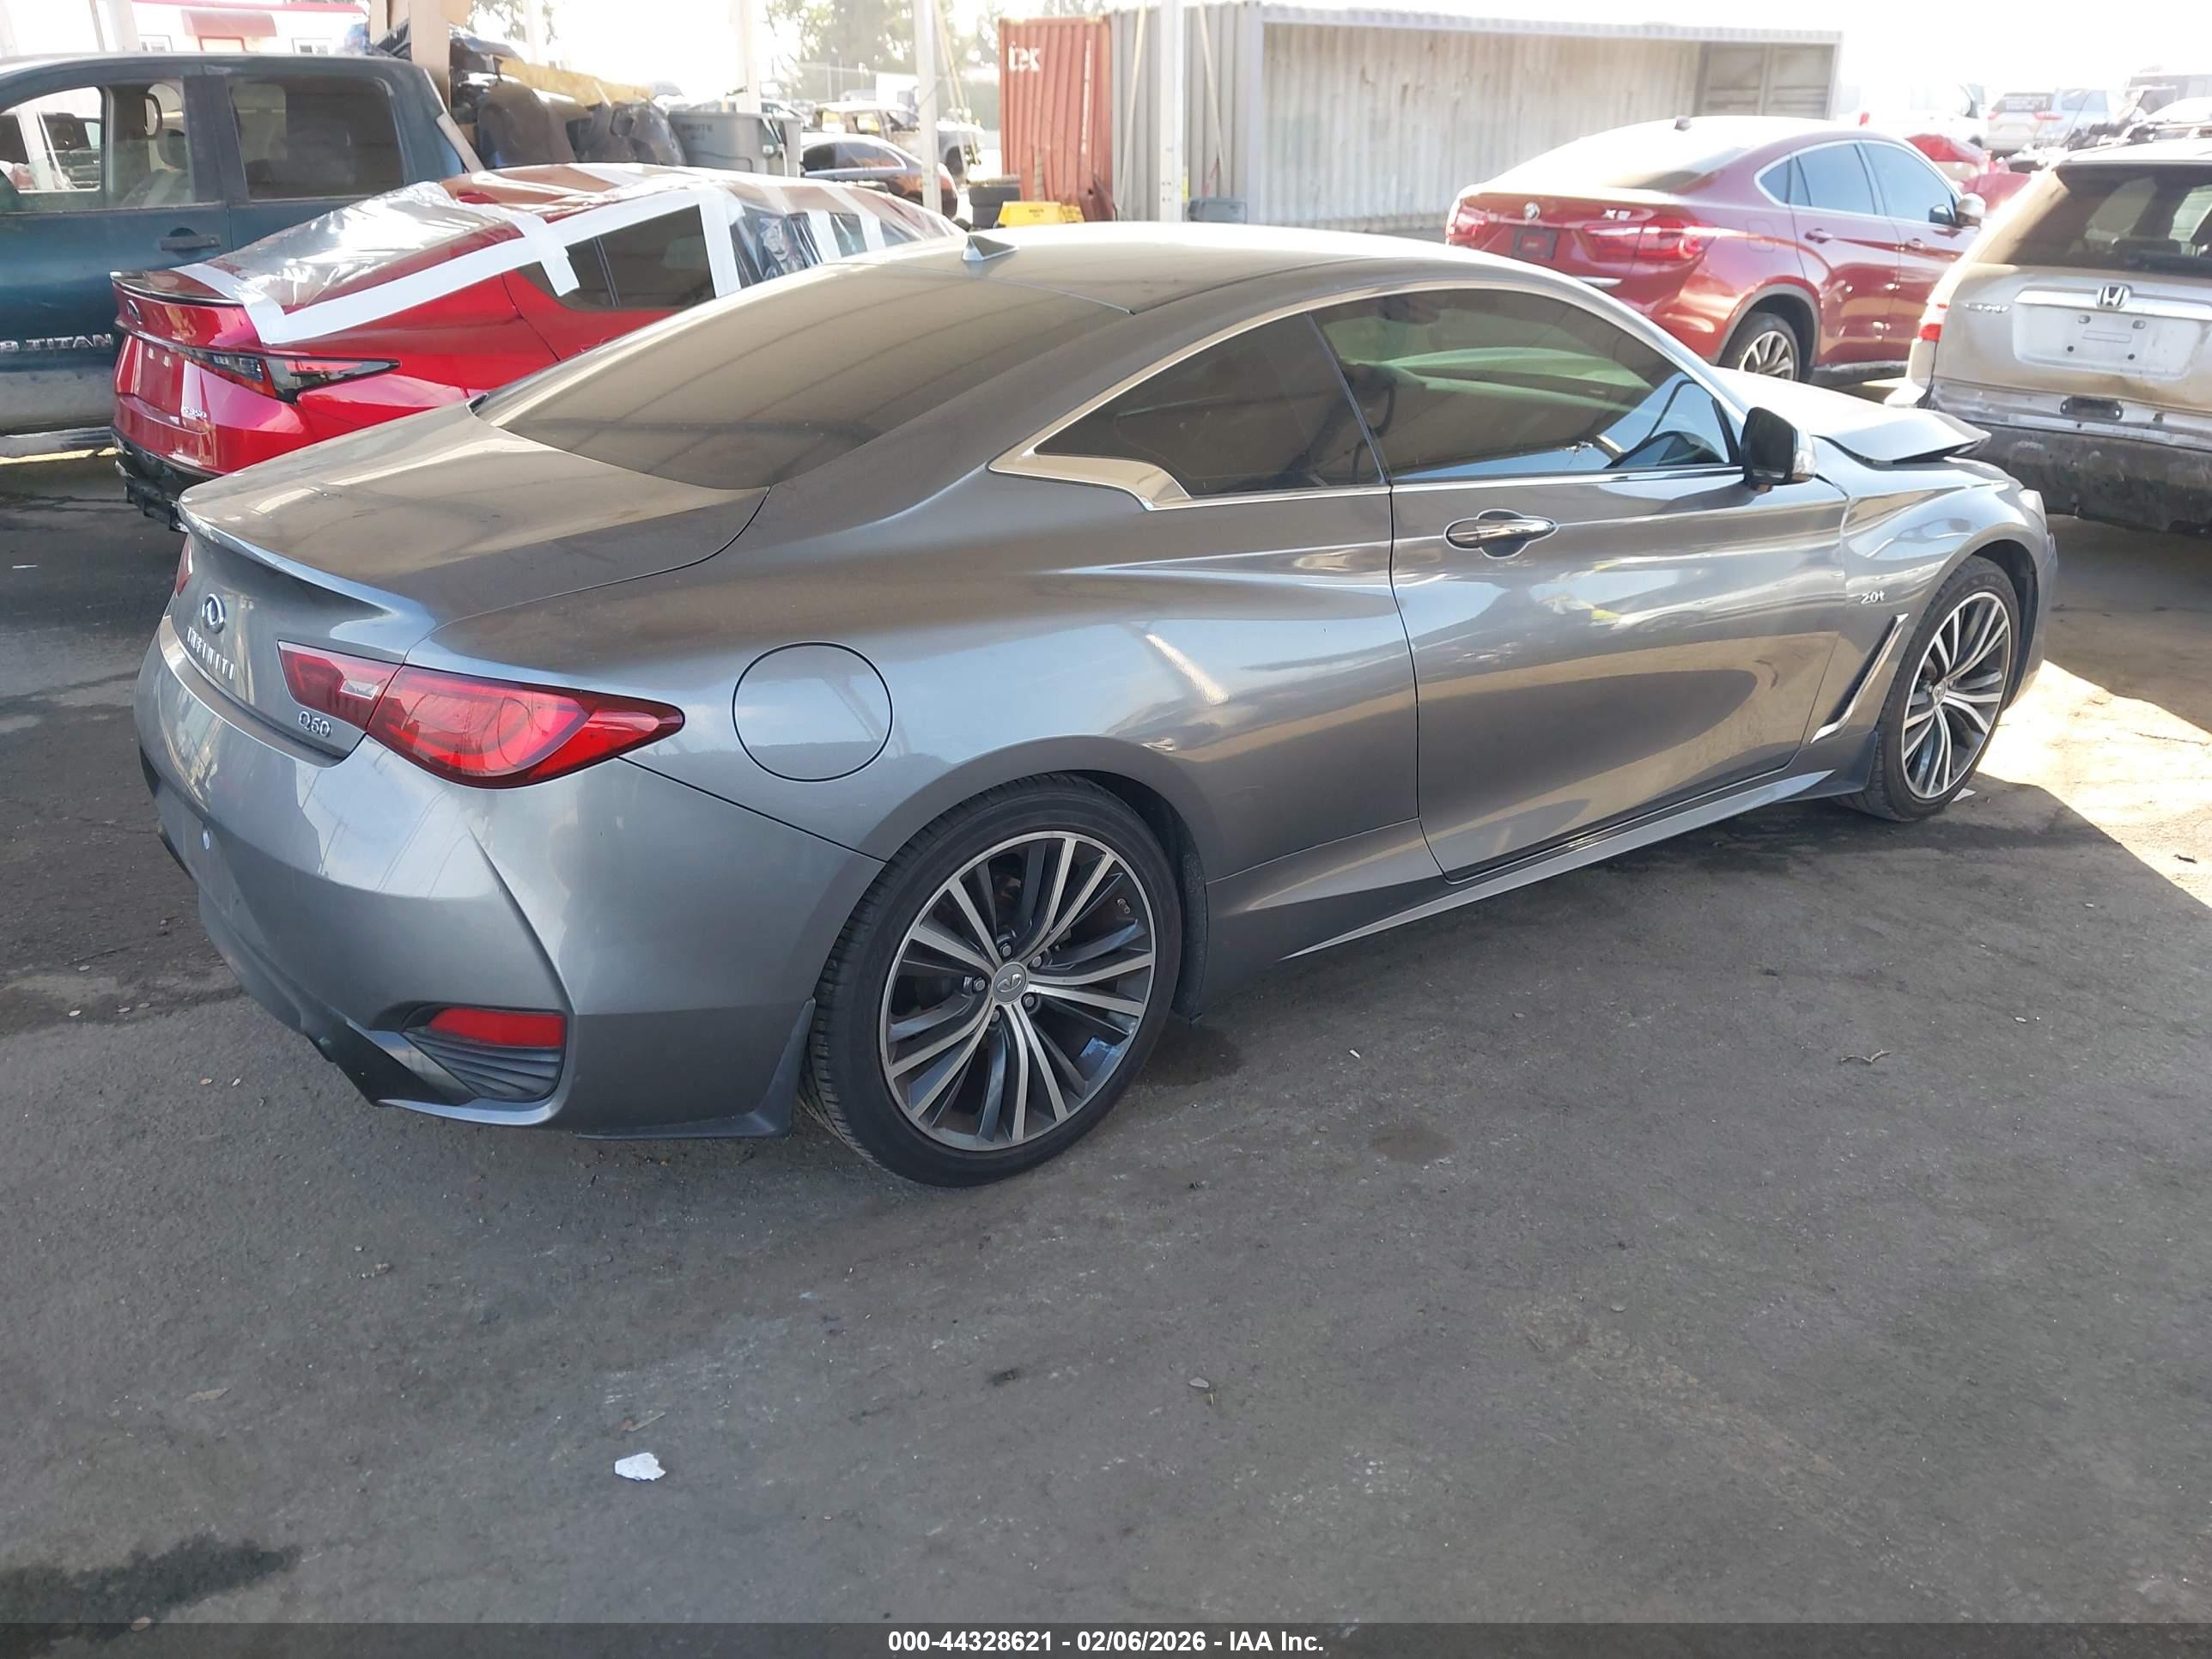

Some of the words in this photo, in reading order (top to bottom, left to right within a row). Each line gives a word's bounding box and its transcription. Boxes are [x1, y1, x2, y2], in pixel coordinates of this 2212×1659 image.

[26, 333, 112, 350] TITAN
[187, 626, 234, 680] INFINITI
[299, 711, 331, 737] Q60
